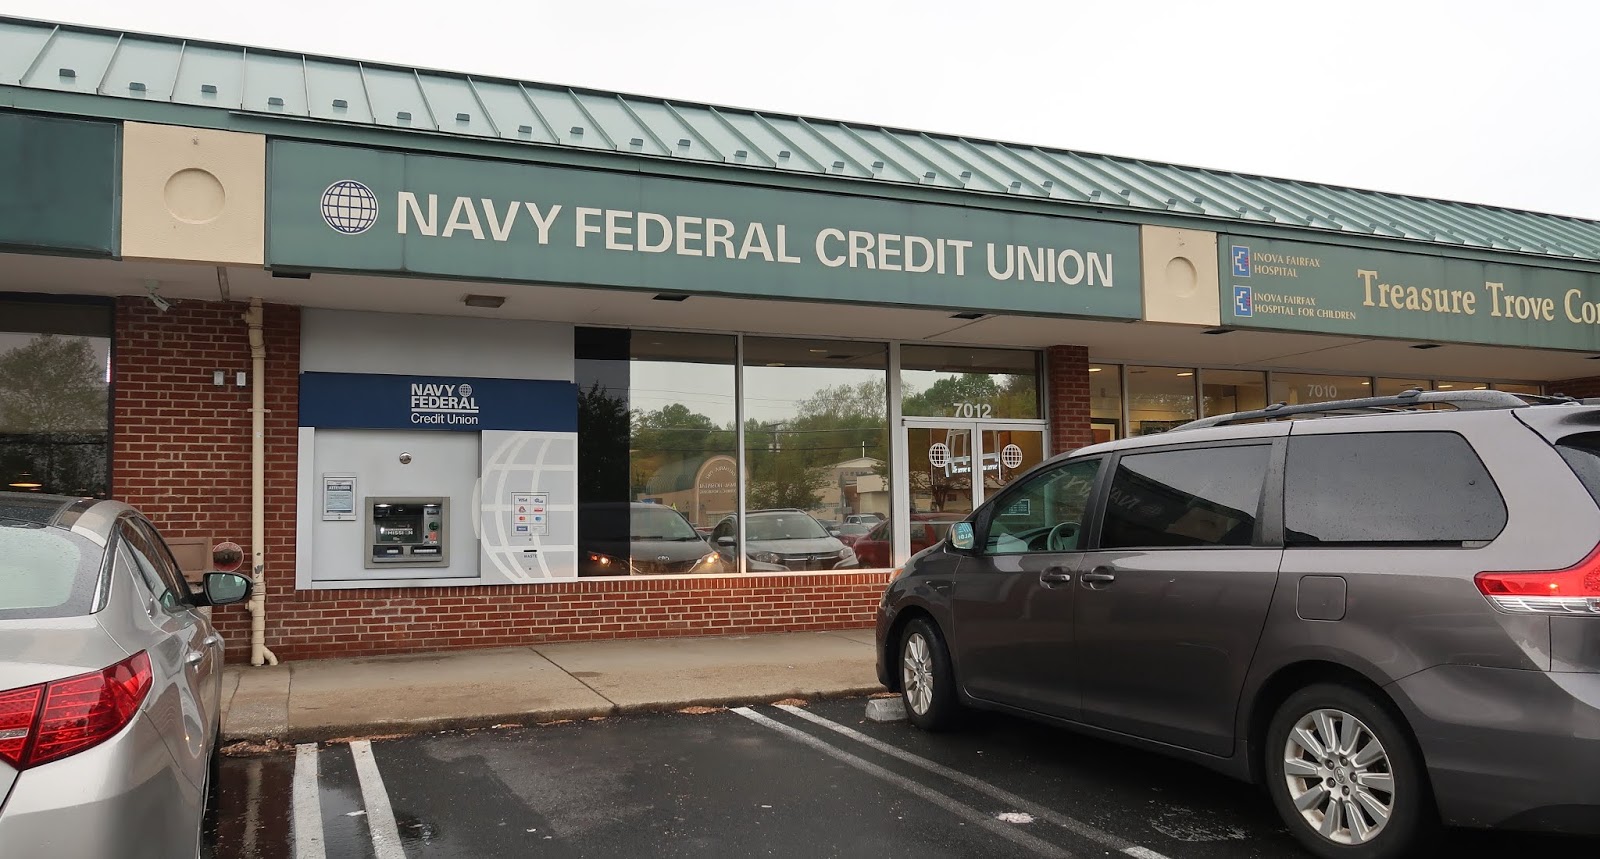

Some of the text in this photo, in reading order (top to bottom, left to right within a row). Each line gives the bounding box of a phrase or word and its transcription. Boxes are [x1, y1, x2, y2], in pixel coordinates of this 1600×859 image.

[397, 191, 1114, 288] NAVY FEDERAL CREDIT UNION
[1253, 252, 1321, 268] INOVA FAIRFAX
[1254, 265, 1298, 278] HOSPITAL
[1253, 292, 1316, 306] INOVA FAIRFAX
[1357, 269, 1476, 315] Treasure
[1485, 281, 1555, 322] Trove
[1254, 304, 1357, 320] HOSPITAL FOR CHILDREN
[411, 383, 456, 397] NAVY
[1307, 384, 1337, 398] 7010
[411, 395, 480, 409] FEDERAL
[953, 402, 992, 419] 7012
[410, 413, 479, 425] Credit Union
